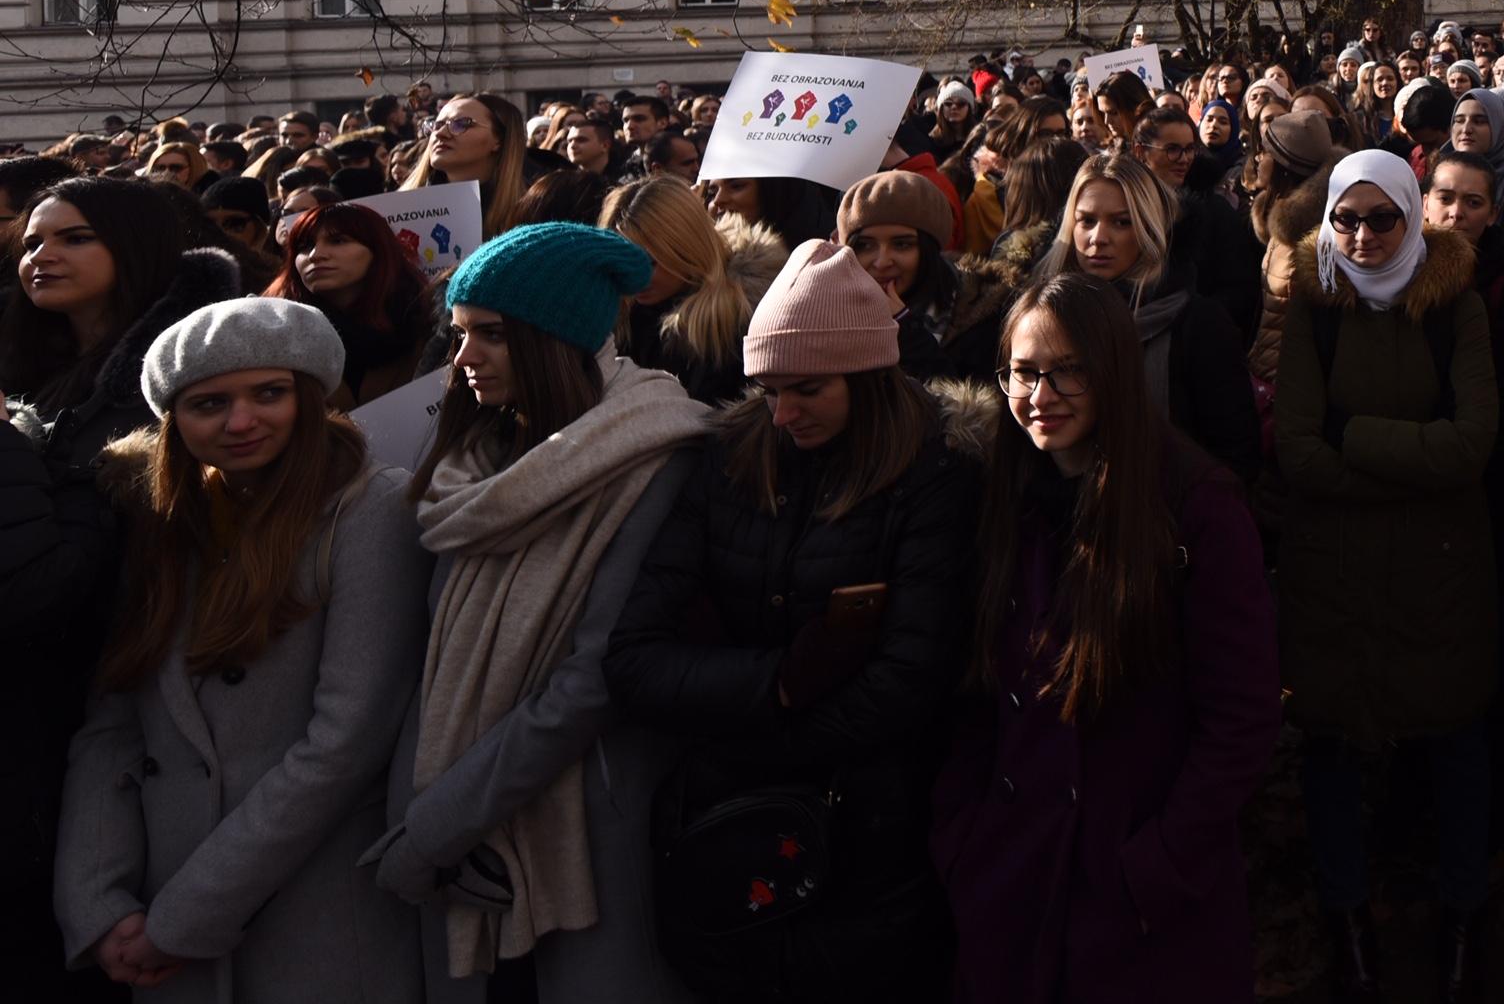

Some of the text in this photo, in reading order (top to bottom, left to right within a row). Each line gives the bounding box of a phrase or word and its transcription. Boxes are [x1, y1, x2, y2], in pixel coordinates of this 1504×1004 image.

[771, 74, 865, 90] BEZ OBRAZOVANJA
[746, 131, 833, 146] BEZ BUDUĆNOSTI
[387, 207, 450, 224] RAZOVANJA
